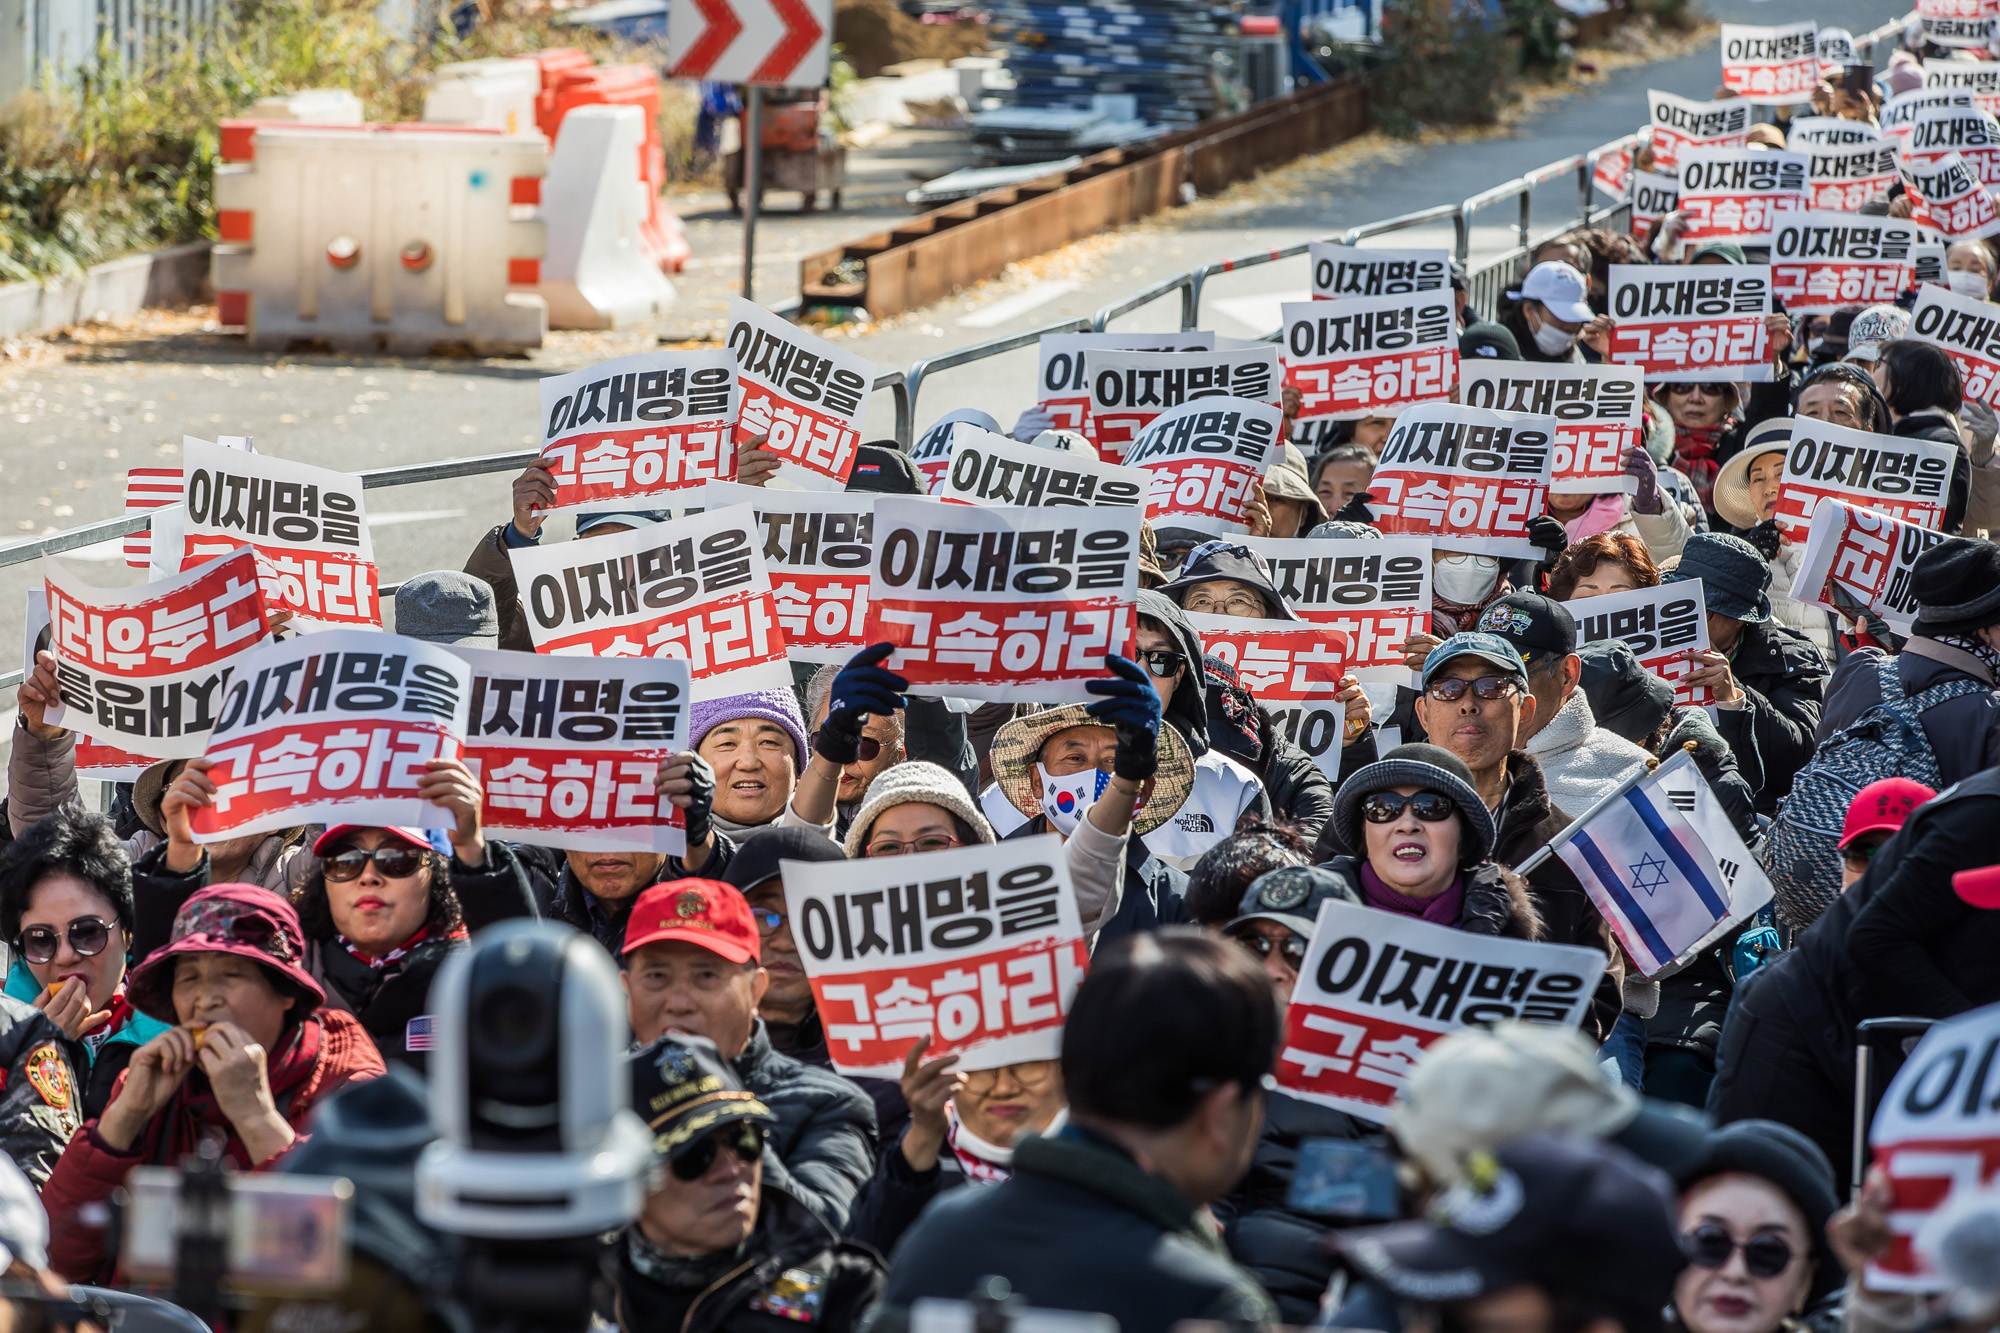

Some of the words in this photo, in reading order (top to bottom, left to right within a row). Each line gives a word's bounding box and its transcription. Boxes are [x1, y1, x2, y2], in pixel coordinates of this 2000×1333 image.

[1728, 32, 1815, 60] 이재명을
[1657, 104, 1746, 136] 이재명을
[1685, 160, 1804, 190] 이재명을
[1810, 147, 1897, 177] 재명을
[1777, 225, 1912, 260] 이재명을
[1316, 259, 1444, 296] 이재명을
[1615, 278, 1765, 318] 이재명을
[1775, 267, 1911, 300] 구속하라
[1290, 304, 1450, 357] 이재명을
[1612, 320, 1767, 364] 구속하라
[728, 321, 866, 417] 이재명을
[1096, 362, 1271, 408] 이재명을
[1301, 352, 1456, 408] 구속하라
[547, 367, 731, 438] 이재명을
[1468, 378, 1635, 420] 이재명을
[738, 384, 854, 474] 속하라
[1123, 410, 1274, 466] 이재명을
[1380, 422, 1548, 473] 이재명을
[1553, 428, 1636, 473] 하라
[545, 427, 736, 490] 구속하라
[1789, 438, 1947, 497] 이재명을
[188, 468, 360, 547] 이재명을
[1146, 464, 1256, 520] 속하라
[1369, 477, 1545, 532] 구속하라
[755, 510, 873, 569] 재명
[879, 527, 1131, 593] 이재명을
[192, 543, 372, 618] 하라
[530, 529, 752, 629] 이재명을
[1270, 556, 1424, 605] 재명을
[550, 597, 772, 671] 하라
[773, 582, 868, 637] 속하
[1575, 599, 1699, 656] 명을
[879, 606, 1131, 672] 구속하라
[58, 660, 234, 737] 재명을
[215, 652, 459, 735] 이재명을
[467, 676, 681, 742] 재명을
[205, 727, 460, 814] 구속하라
[464, 757, 675, 819] 속하라
[1181, 825, 1201, 833] FACE
[801, 864, 1059, 962] 이재명을
[820, 946, 1085, 1052] 구속하라
[1315, 936, 1584, 1026] 이재명을
[1281, 1013, 1427, 1098] 구속
